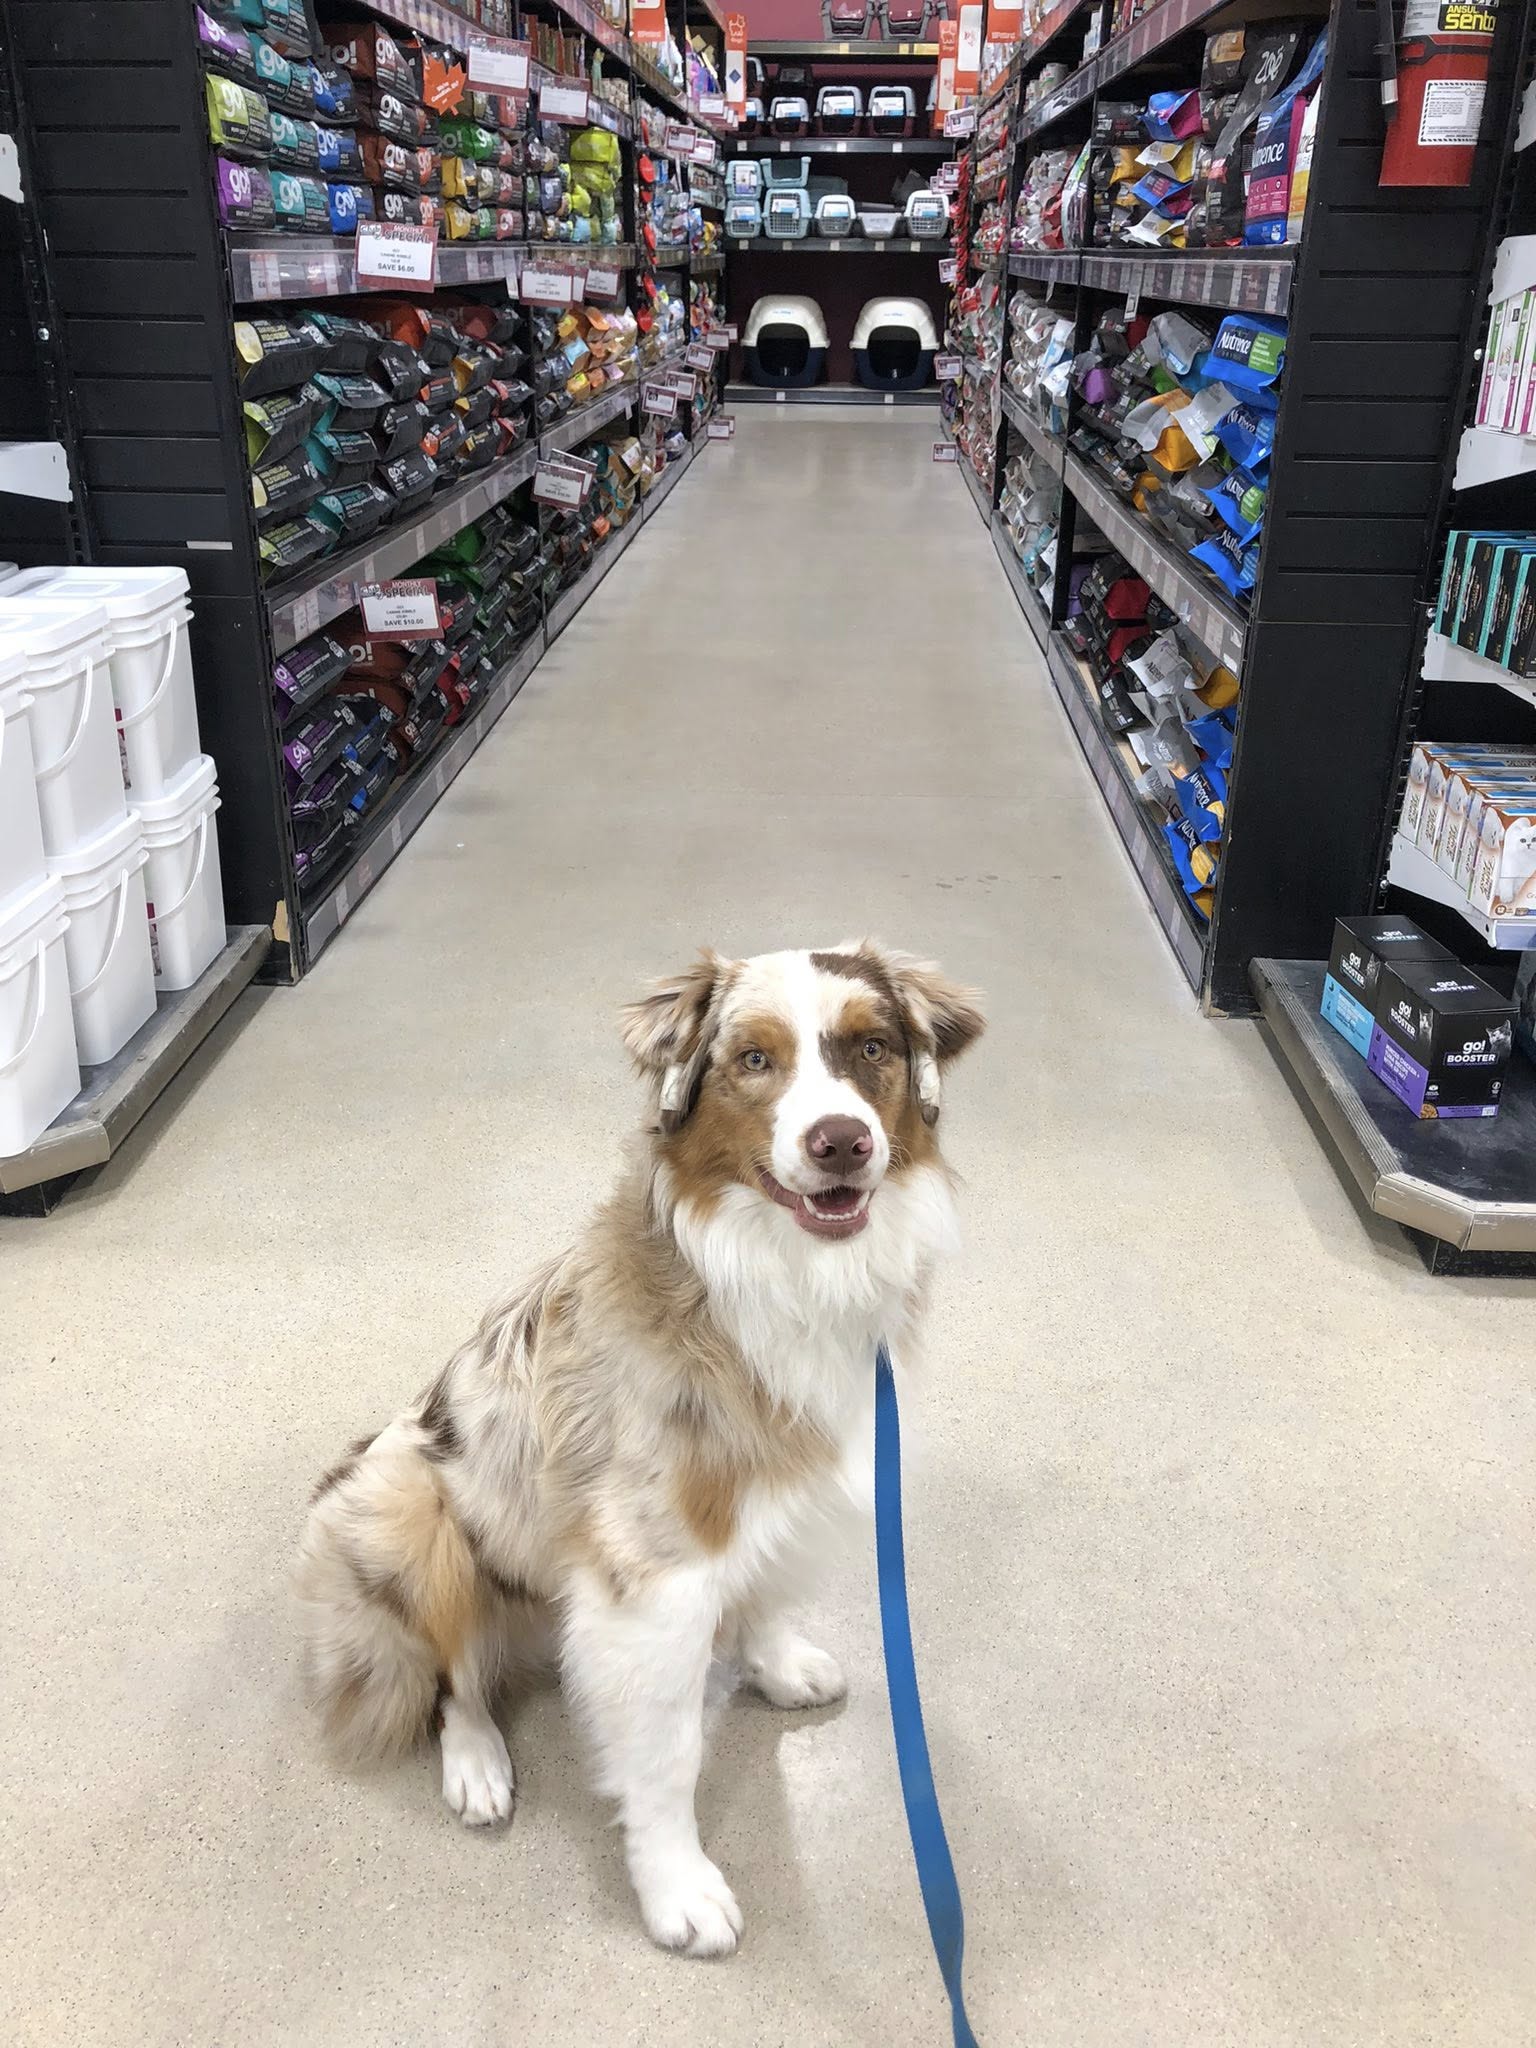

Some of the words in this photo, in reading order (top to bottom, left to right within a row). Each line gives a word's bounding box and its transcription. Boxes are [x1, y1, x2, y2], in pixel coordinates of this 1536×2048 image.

[384, 231, 431, 243] SPECIAL
[378, 263, 396, 271] SAVE
[385, 586, 430, 598] SPECIAL
[384, 619, 402, 627] SAVE
[403, 618, 424, 626] $10.00
[1349, 952, 1362, 968] go!
[1342, 959, 1365, 985] BOOSTER
[1398, 1000, 1412, 1018] go!
[1391, 1007, 1416, 1037] BOOSTER
[1462, 1040, 1486, 1055] go!
[1446, 1053, 1497, 1063] BOOSTER
